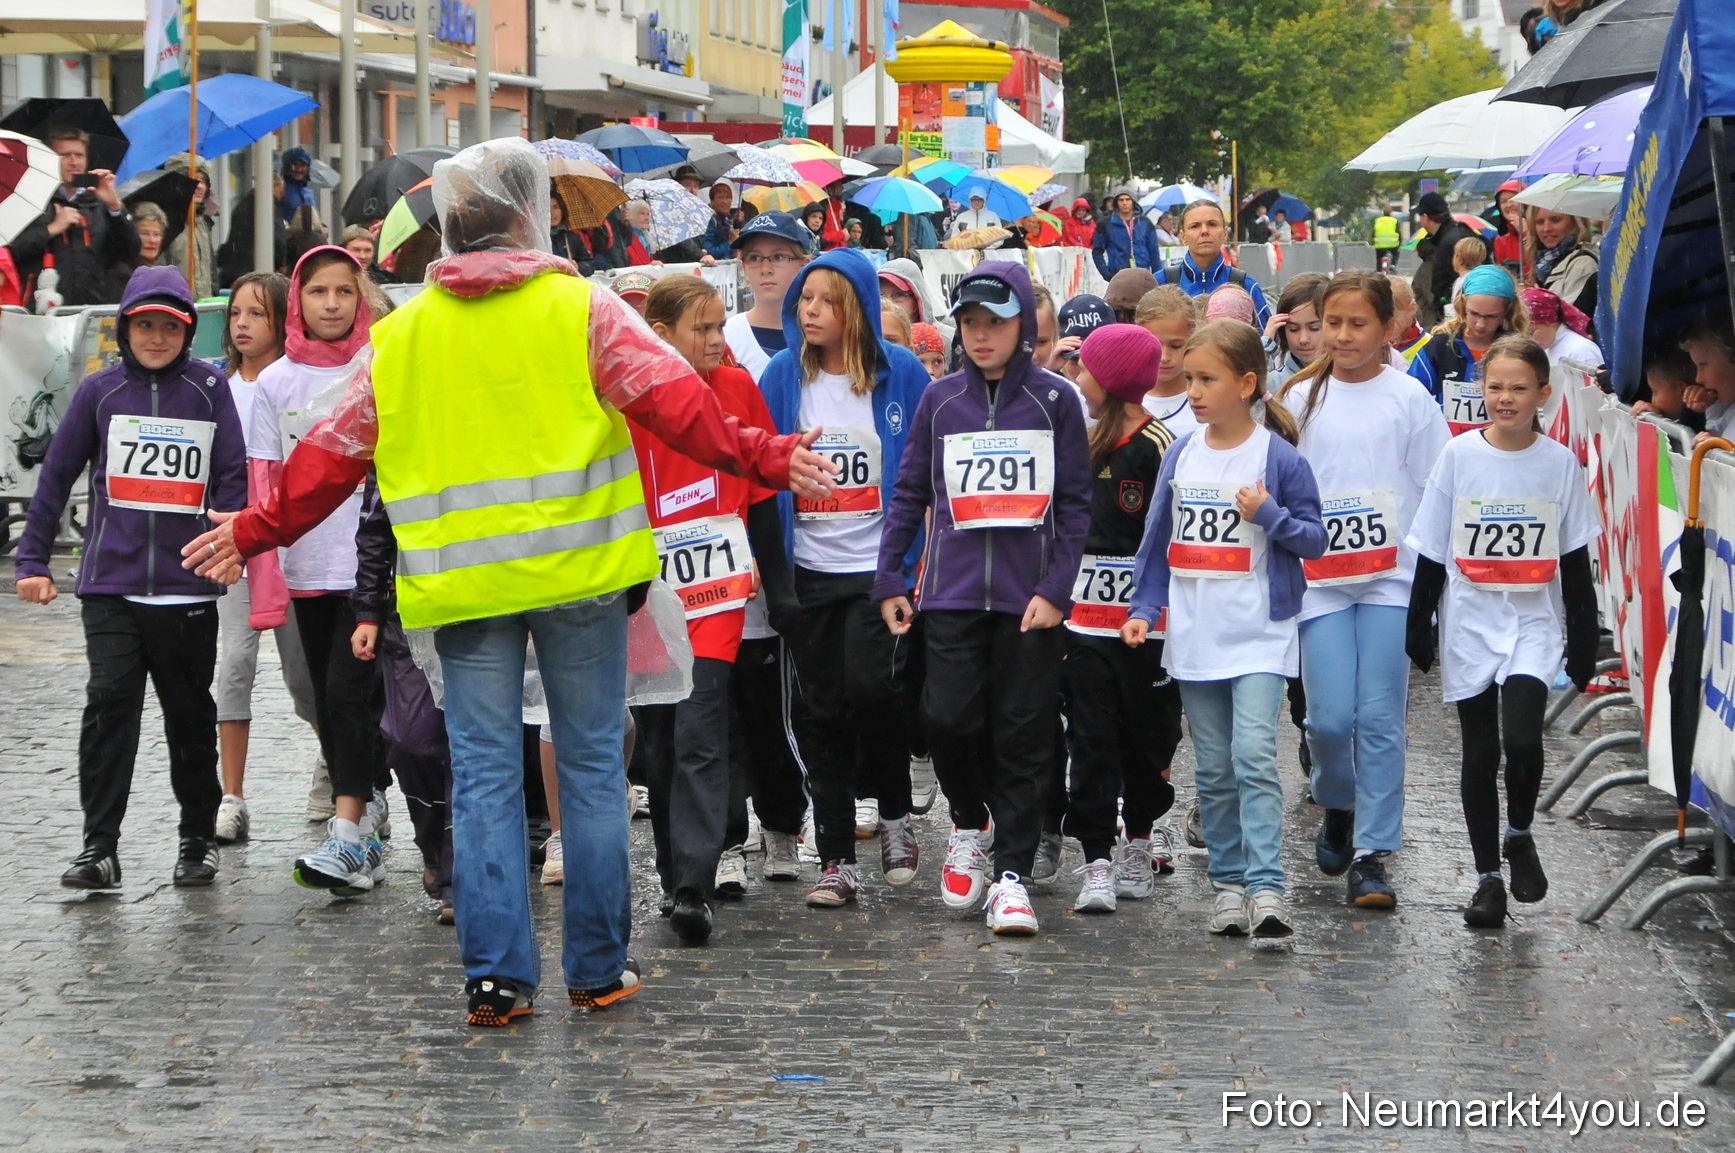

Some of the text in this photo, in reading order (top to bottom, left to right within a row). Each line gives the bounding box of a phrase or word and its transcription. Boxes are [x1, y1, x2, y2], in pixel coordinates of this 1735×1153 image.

[1064, 312, 1103, 333] ALINA
[139, 424, 184, 436] BOCK
[812, 433, 849, 444] OCK
[972, 438, 1019, 450] BOCK
[120, 441, 202, 480] 7290
[956, 457, 1036, 493] 7291
[674, 488, 700, 506] DEHN
[1322, 497, 1361, 510] BOCK
[1480, 504, 1526, 516] BOCK
[664, 524, 710, 544] BOCK
[1326, 513, 1387, 552] 235
[1464, 523, 1546, 557] 7237
[659, 538, 736, 584] 7071
